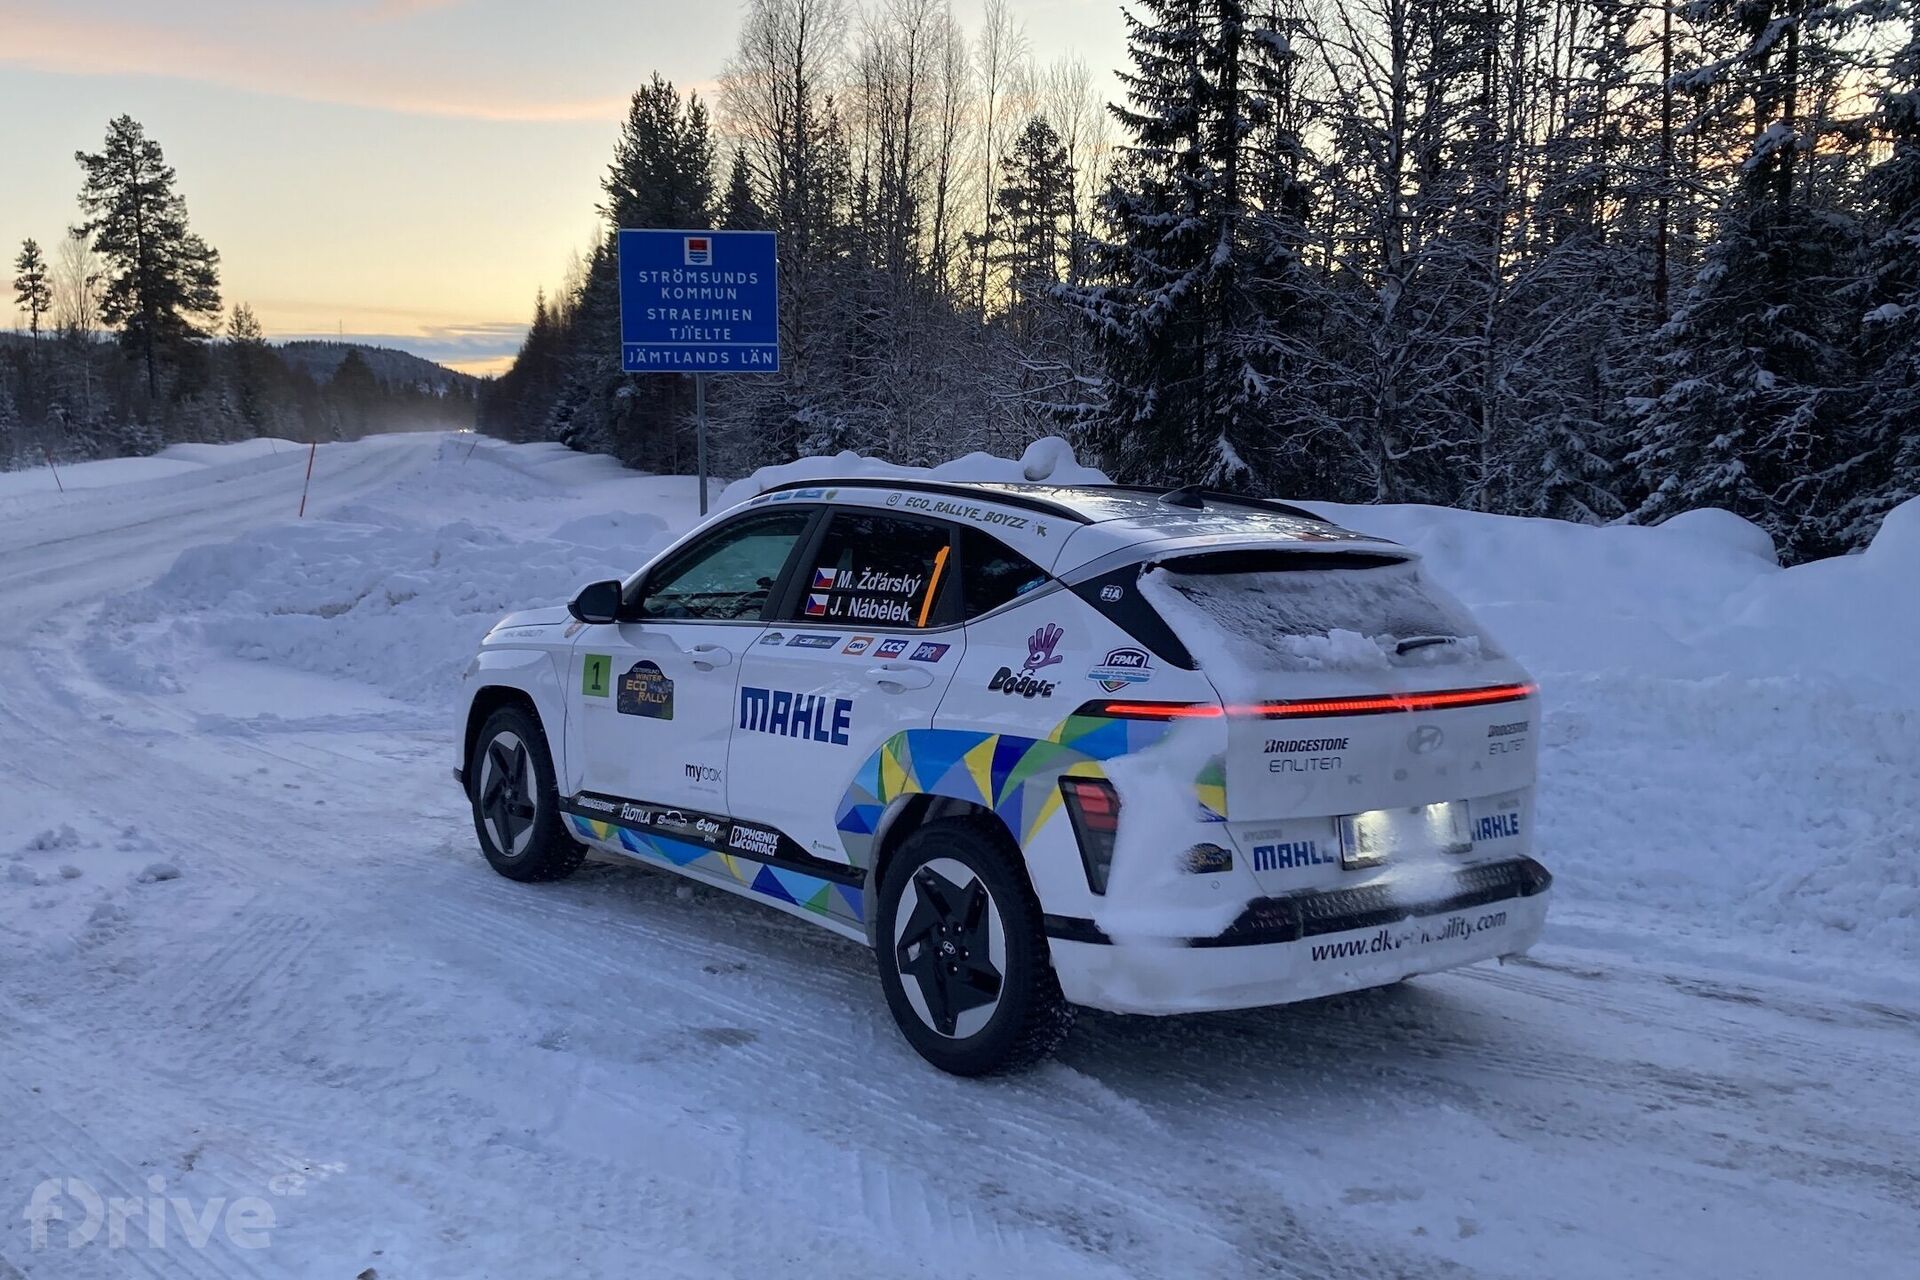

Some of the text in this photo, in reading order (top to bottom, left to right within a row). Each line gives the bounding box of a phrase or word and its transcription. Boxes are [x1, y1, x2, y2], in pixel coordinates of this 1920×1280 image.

[639, 268, 758, 285] STRÖMSUNDS
[661, 287, 737, 300] KOMMUN
[647, 308, 752, 321] STRAEJMIEN
[628, 348, 773, 364] JÄMTLANDS LÄN
[905, 496, 1029, 530] ECO_RALLYE_BOYZZ
[837, 566, 922, 598] M. Žďárský
[1101, 585, 1122, 601] FIA
[829, 596, 912, 622] J. Nábělek
[881, 640, 904, 653] CCS
[1110, 655, 1142, 665] FPAK
[591, 661, 601, 691] 1
[635, 673, 663, 682] WINTER
[626, 679, 648, 692] ECO
[638, 691, 668, 704] RALLY
[739, 686, 853, 746] MAHLE
[1264, 737, 1349, 754] BRIDGESTONE
[1269, 756, 1342, 773] ENLITEN
[620, 802, 651, 825] FLOTILA
[740, 838, 778, 857] CONTACT
